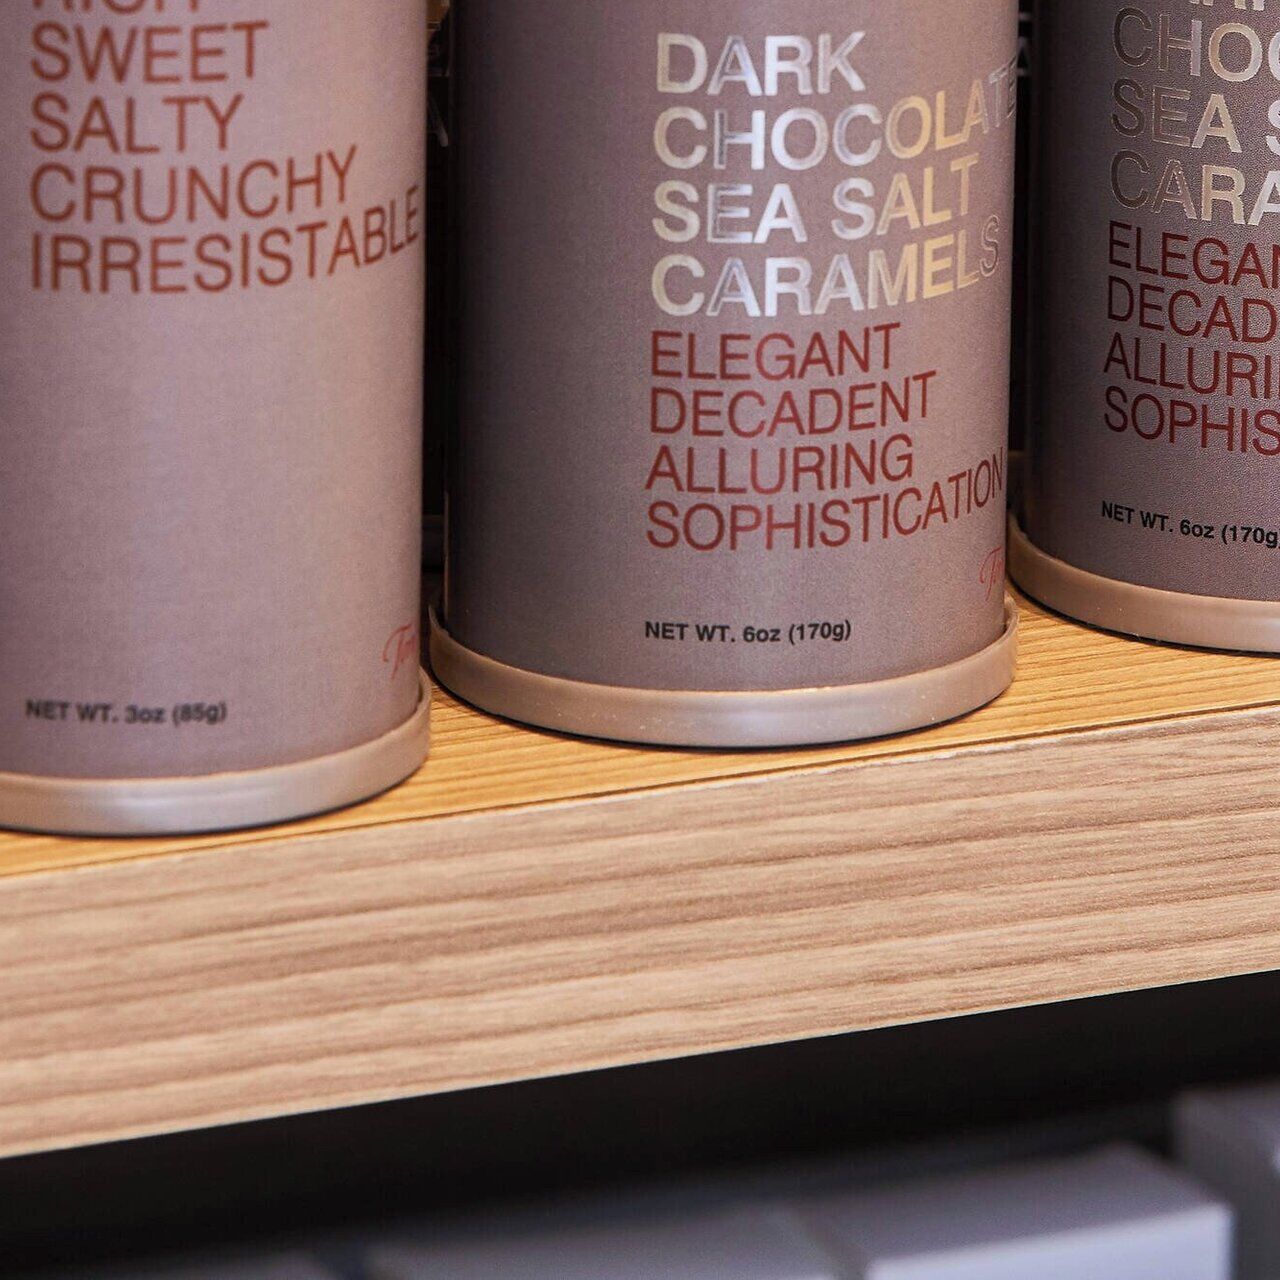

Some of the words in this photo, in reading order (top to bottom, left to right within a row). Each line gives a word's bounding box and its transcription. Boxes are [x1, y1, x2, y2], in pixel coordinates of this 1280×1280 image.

[30, 20, 270, 83] SWEET
[656, 30, 866, 96] DARK
[29, 91, 243, 154] SALTY
[653, 54, 1017, 171] CHOCOLATE
[1111, 77, 1243, 154] SEA
[29, 143, 357, 225] CRUNCHY
[652, 179, 808, 244] SEA
[830, 151, 980, 240] SALT
[31, 184, 419, 294] IRRESISTABLE
[651, 213, 1000, 317] CARAMELS
[650, 321, 901, 381] ELEGANT
[649, 370, 937, 439] DECADENT
[644, 433, 914, 494] ALLURING
[646, 446, 1004, 552] SOPHISTICATION
[1101, 500, 1135, 525] NET
[1140, 508, 1174, 533] WT.
[1179, 518, 1215, 539] 6oz
[645, 621, 689, 640] NET
[695, 624, 735, 642] WT.
[742, 625, 781, 642] 6oz
[788, 620, 852, 646] (170g)
[26, 699, 69, 721] NET
[77, 702, 118, 724] WT.
[125, 704, 165, 725] 3oz
[172, 700, 228, 728] (85g)
